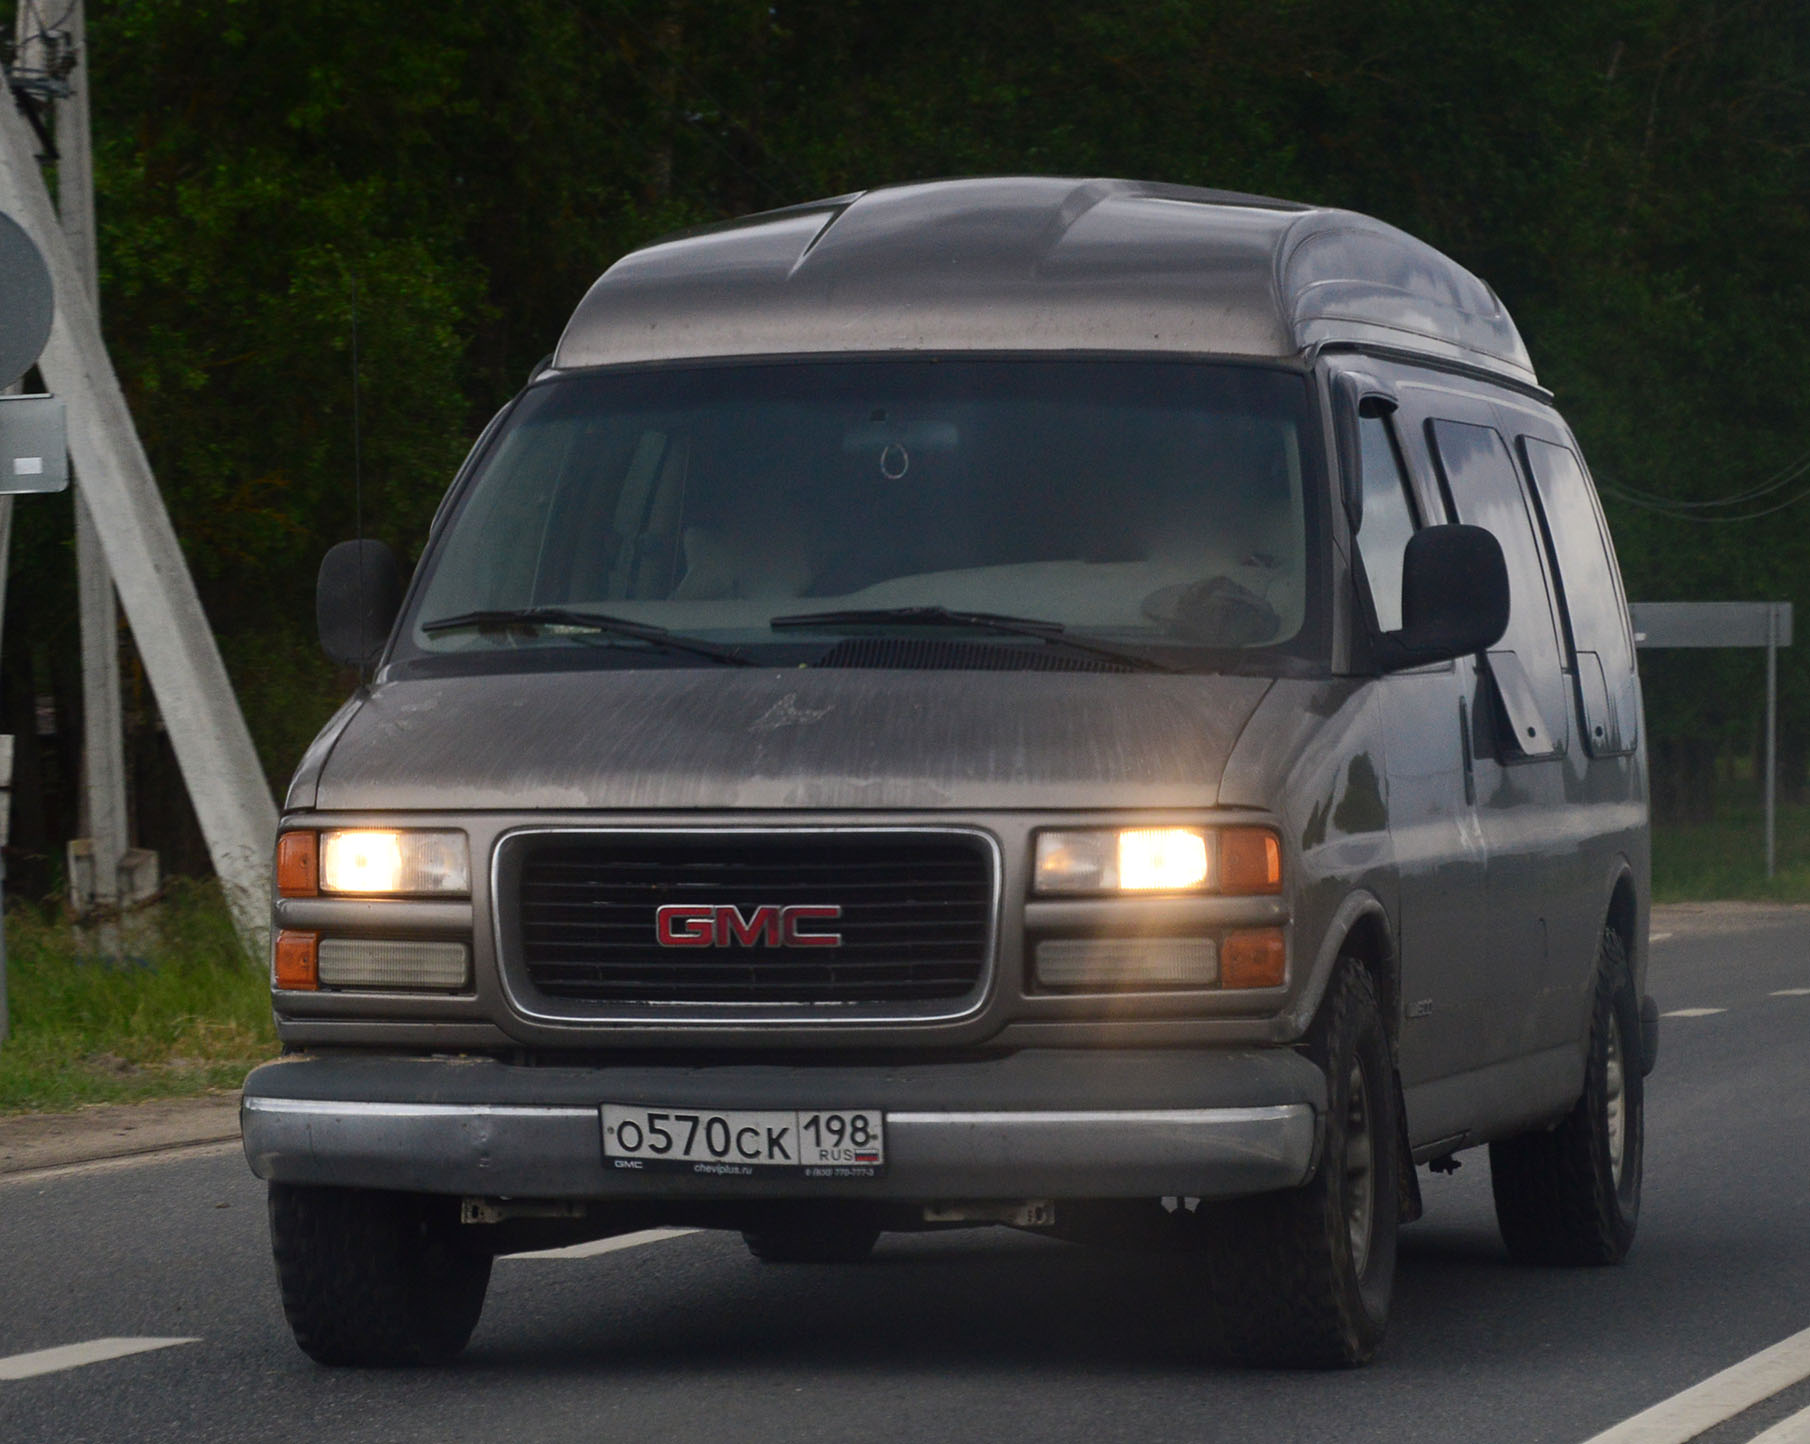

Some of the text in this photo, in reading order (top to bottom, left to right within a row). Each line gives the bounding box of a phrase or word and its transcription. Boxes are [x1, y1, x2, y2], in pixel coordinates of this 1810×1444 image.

[656, 904, 841, 948] GMC
[803, 1114, 870, 1148] 198
[614, 1160, 643, 1169] GMC
[819, 1149, 854, 1161] RUS
